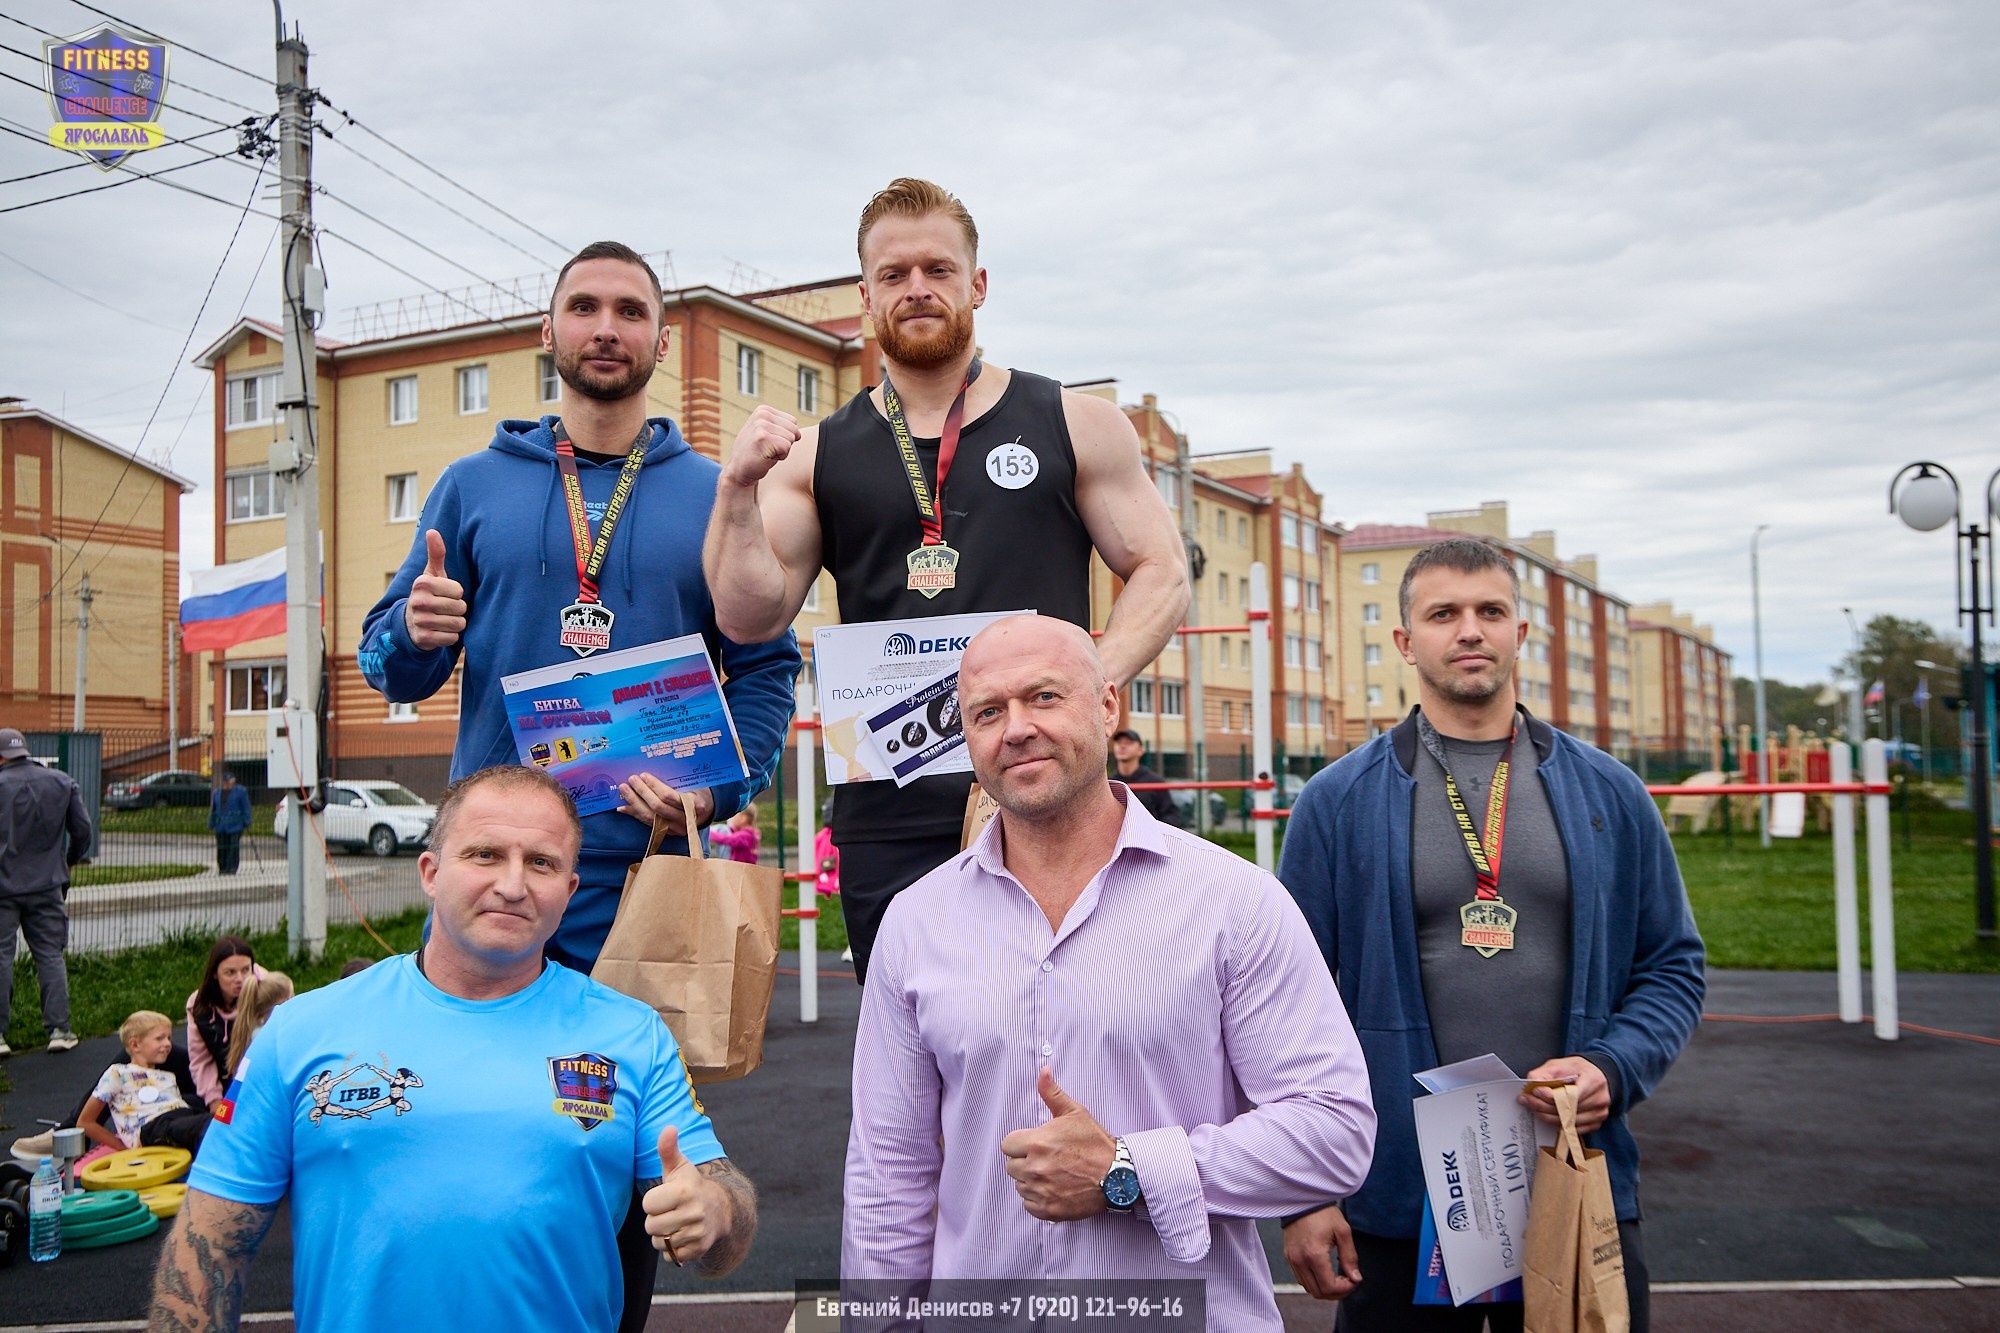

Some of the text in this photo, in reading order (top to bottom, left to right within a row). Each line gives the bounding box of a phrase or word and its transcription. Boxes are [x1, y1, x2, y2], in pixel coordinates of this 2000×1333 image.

[893, 418, 934, 516] БИТВА НА СТРЕЛКЕ
[991, 454, 1034, 477] 153
[586, 474, 632, 576] БИТВА НА СТРЕЛКЕ
[910, 574, 954, 588] CHALLENGE
[568, 625, 604, 633] FITNESS
[562, 633, 608, 647] CHALLENGE
[832, 683, 916, 700] ПОДАРОЧН
[905, 686, 940, 708] Protein
[533, 698, 582, 712] БИТВА
[1456, 813, 1474, 830] НА
[1463, 832, 1490, 872] БИТВА
[1465, 931, 1512, 946] CHALLENGE
[560, 1060, 608, 1078] FITNESS
[340, 1087, 380, 1103] IFBB
[562, 1102, 608, 1118] ЯРОСЛАВЛЬ
[1476, 1091, 1497, 1171] СЕРТИФИКАТ
[1485, 1172, 1515, 1269] ПОДАРОЧНЫЙ
